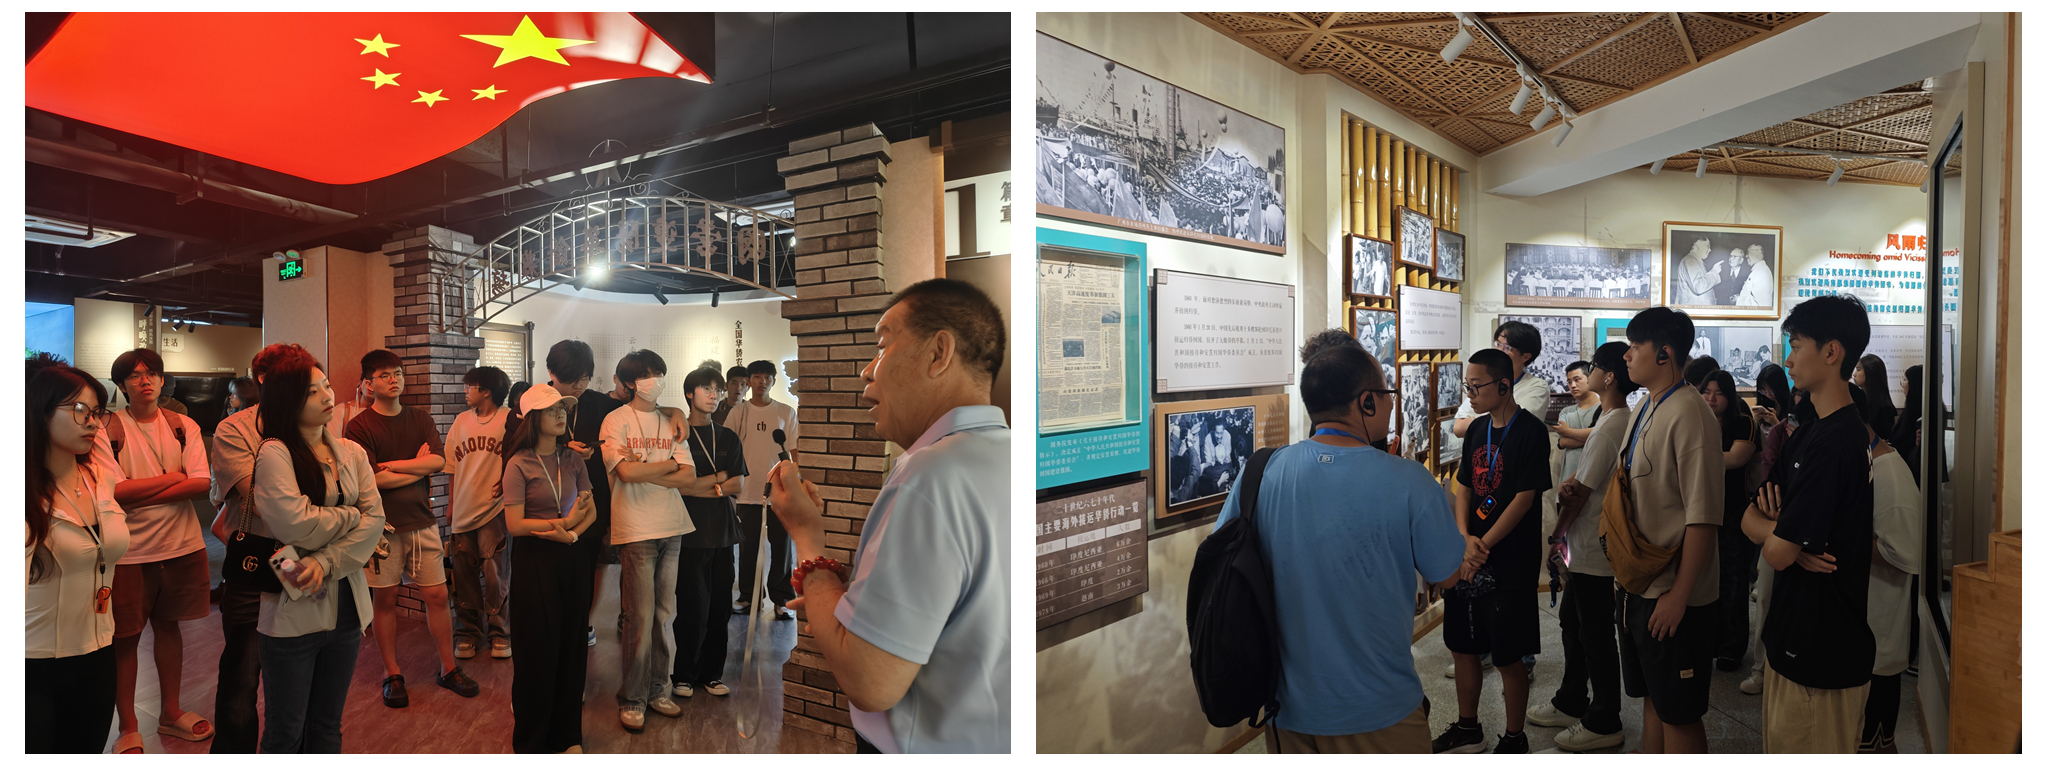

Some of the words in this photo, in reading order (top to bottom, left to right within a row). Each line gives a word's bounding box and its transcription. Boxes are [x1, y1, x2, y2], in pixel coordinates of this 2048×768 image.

[1829, 250, 1881, 262] Homecoming
[1883, 252, 1902, 261] amid
[1798, 278, 1926, 290] 热烈欢迎所有愿意回国的华侨回来，为祖国的
[163, 337, 178, 347] 生活
[1056, 494, 1115, 514] 二十世纪六七十年代
[1070, 545, 1103, 561] 印度尼西亚
[1070, 560, 1103, 576] 印度尼西亚
[1080, 577, 1093, 587] 印度
[1081, 592, 1093, 602] 越南
